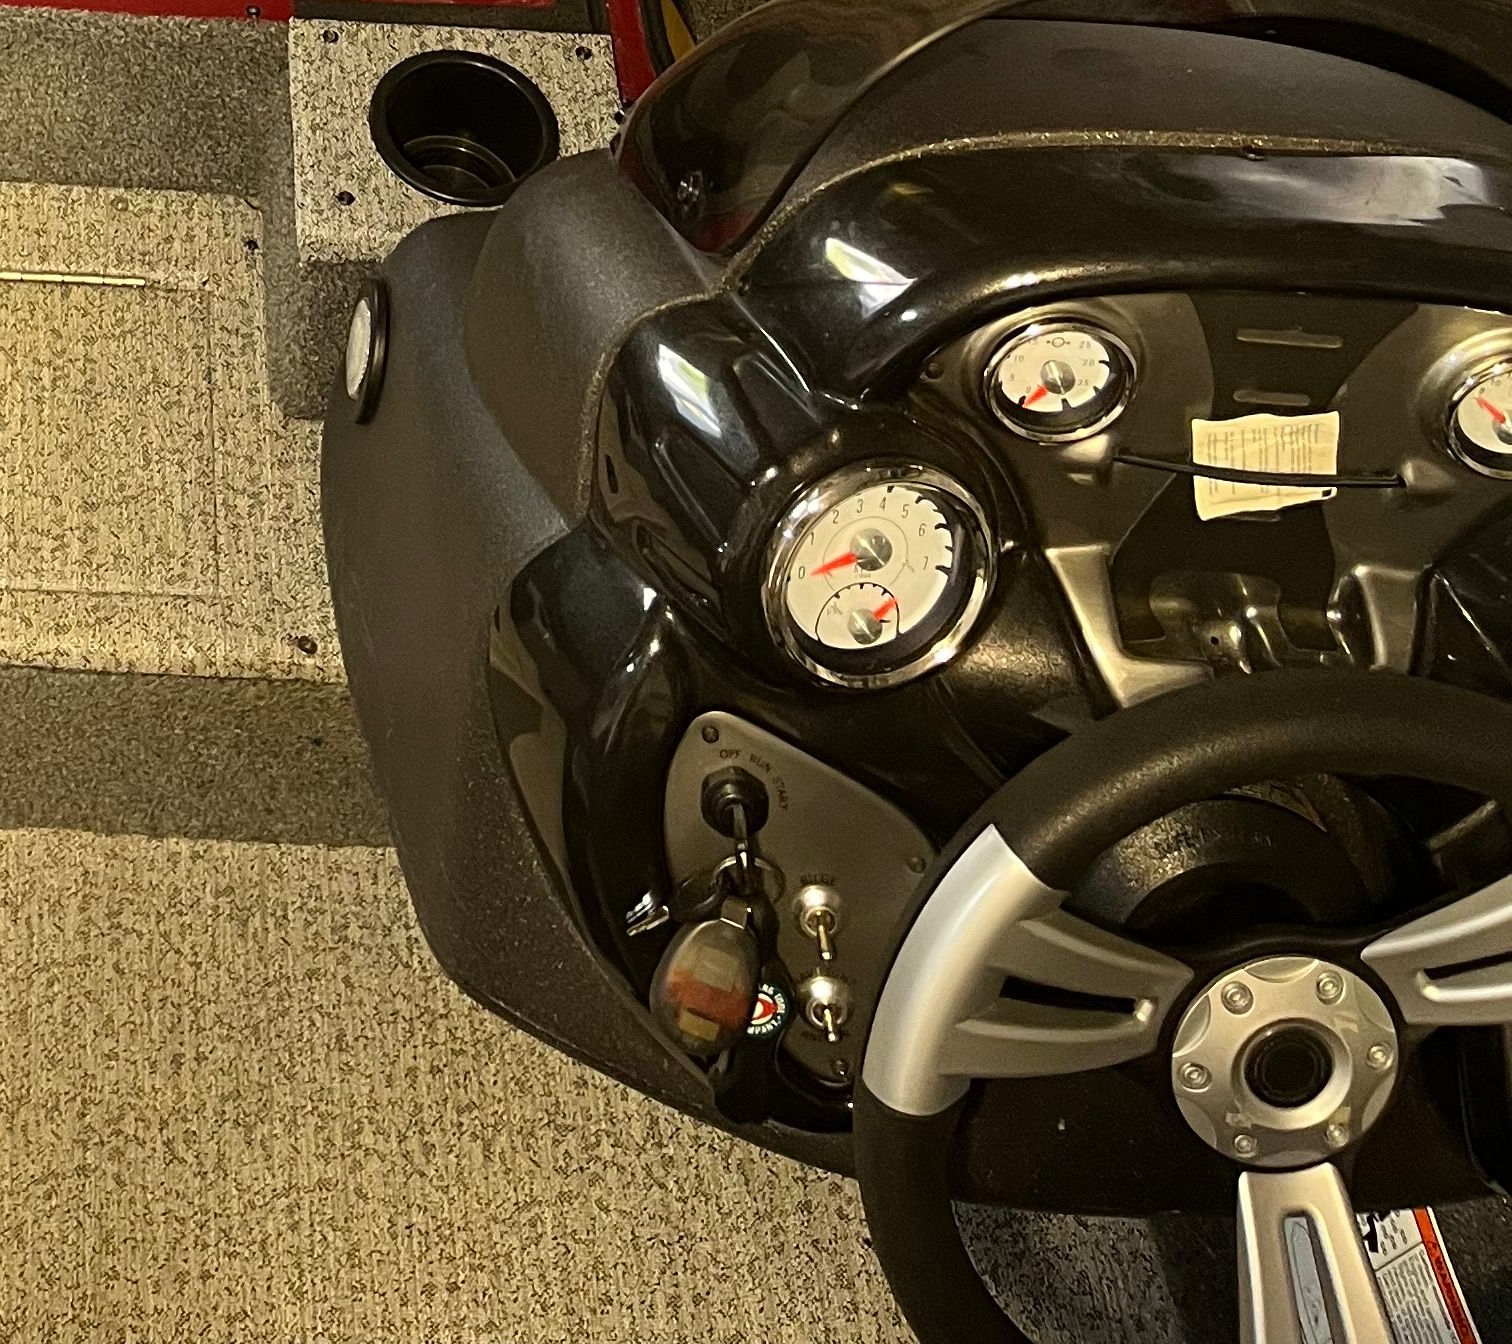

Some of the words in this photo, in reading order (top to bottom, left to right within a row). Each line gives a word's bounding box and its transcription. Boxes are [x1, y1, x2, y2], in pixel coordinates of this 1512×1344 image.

[856, 498, 864, 513] 3
[879, 496, 887, 511] 4
[901, 503, 910, 519] 5
[832, 510, 840, 524] 2
[918, 522, 927, 537] 6
[809, 531, 815, 545] 1
[922, 555, 930, 571] 7
[797, 565, 806, 579] 0
